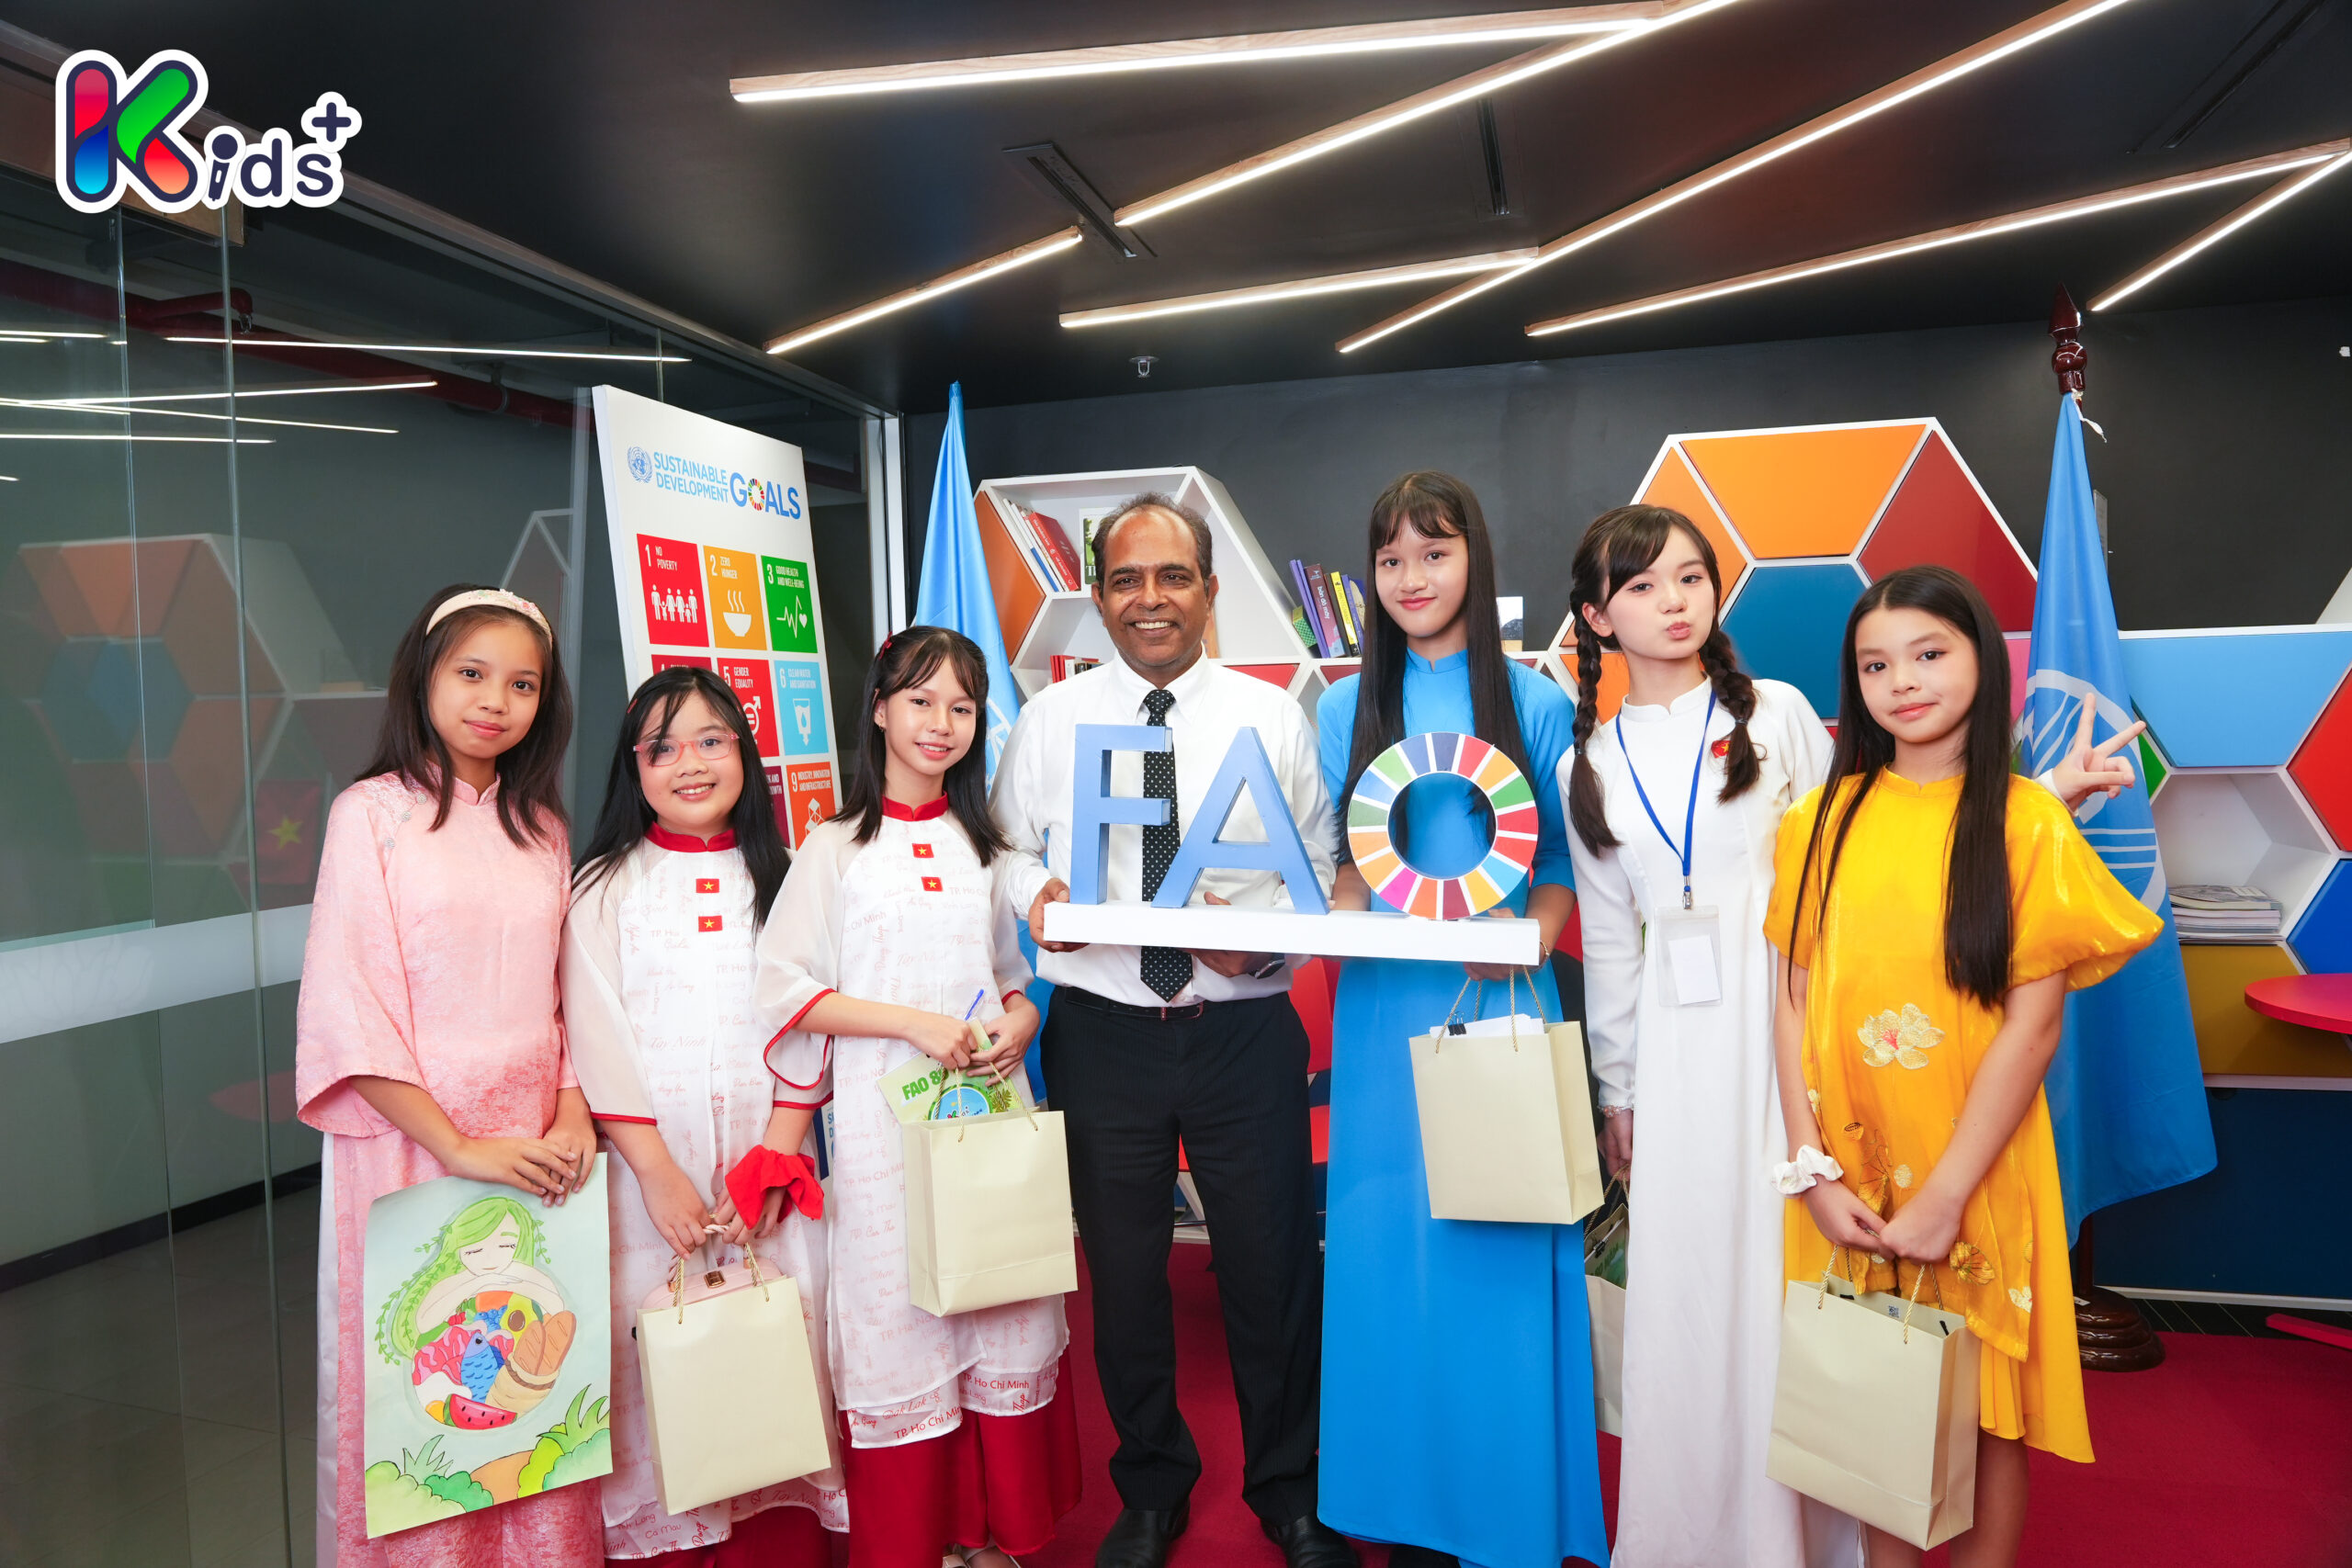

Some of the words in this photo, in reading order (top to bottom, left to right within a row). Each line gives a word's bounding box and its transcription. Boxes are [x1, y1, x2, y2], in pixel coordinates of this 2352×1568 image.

[653, 451, 728, 486] SUSTAINABLE
[656, 472, 729, 502] DEVELOPMENT
[729, 471, 801, 520] GOALS
[645, 544, 651, 567] 1
[655, 546, 662, 557] NO
[657, 558, 677, 571] POVERTY
[709, 554, 718, 577] 2
[719, 556, 730, 568] ZERO
[766, 563, 774, 584] 3
[723, 666, 731, 687] 5
[733, 667, 749, 677] GENDER
[779, 669, 786, 688] 6
[735, 678, 753, 689] EQUALITY
[791, 773, 797, 793] 9
[1069, 723, 1539, 920] FAO
[902, 1077, 929, 1100] FAO
[974, 1377, 988, 1388] Ho
[989, 1380, 1005, 1390] Chi
[1007, 1380, 1030, 1389] Minh
[910, 1422, 926, 1434] Ho
[928, 1414, 945, 1427] Chi
